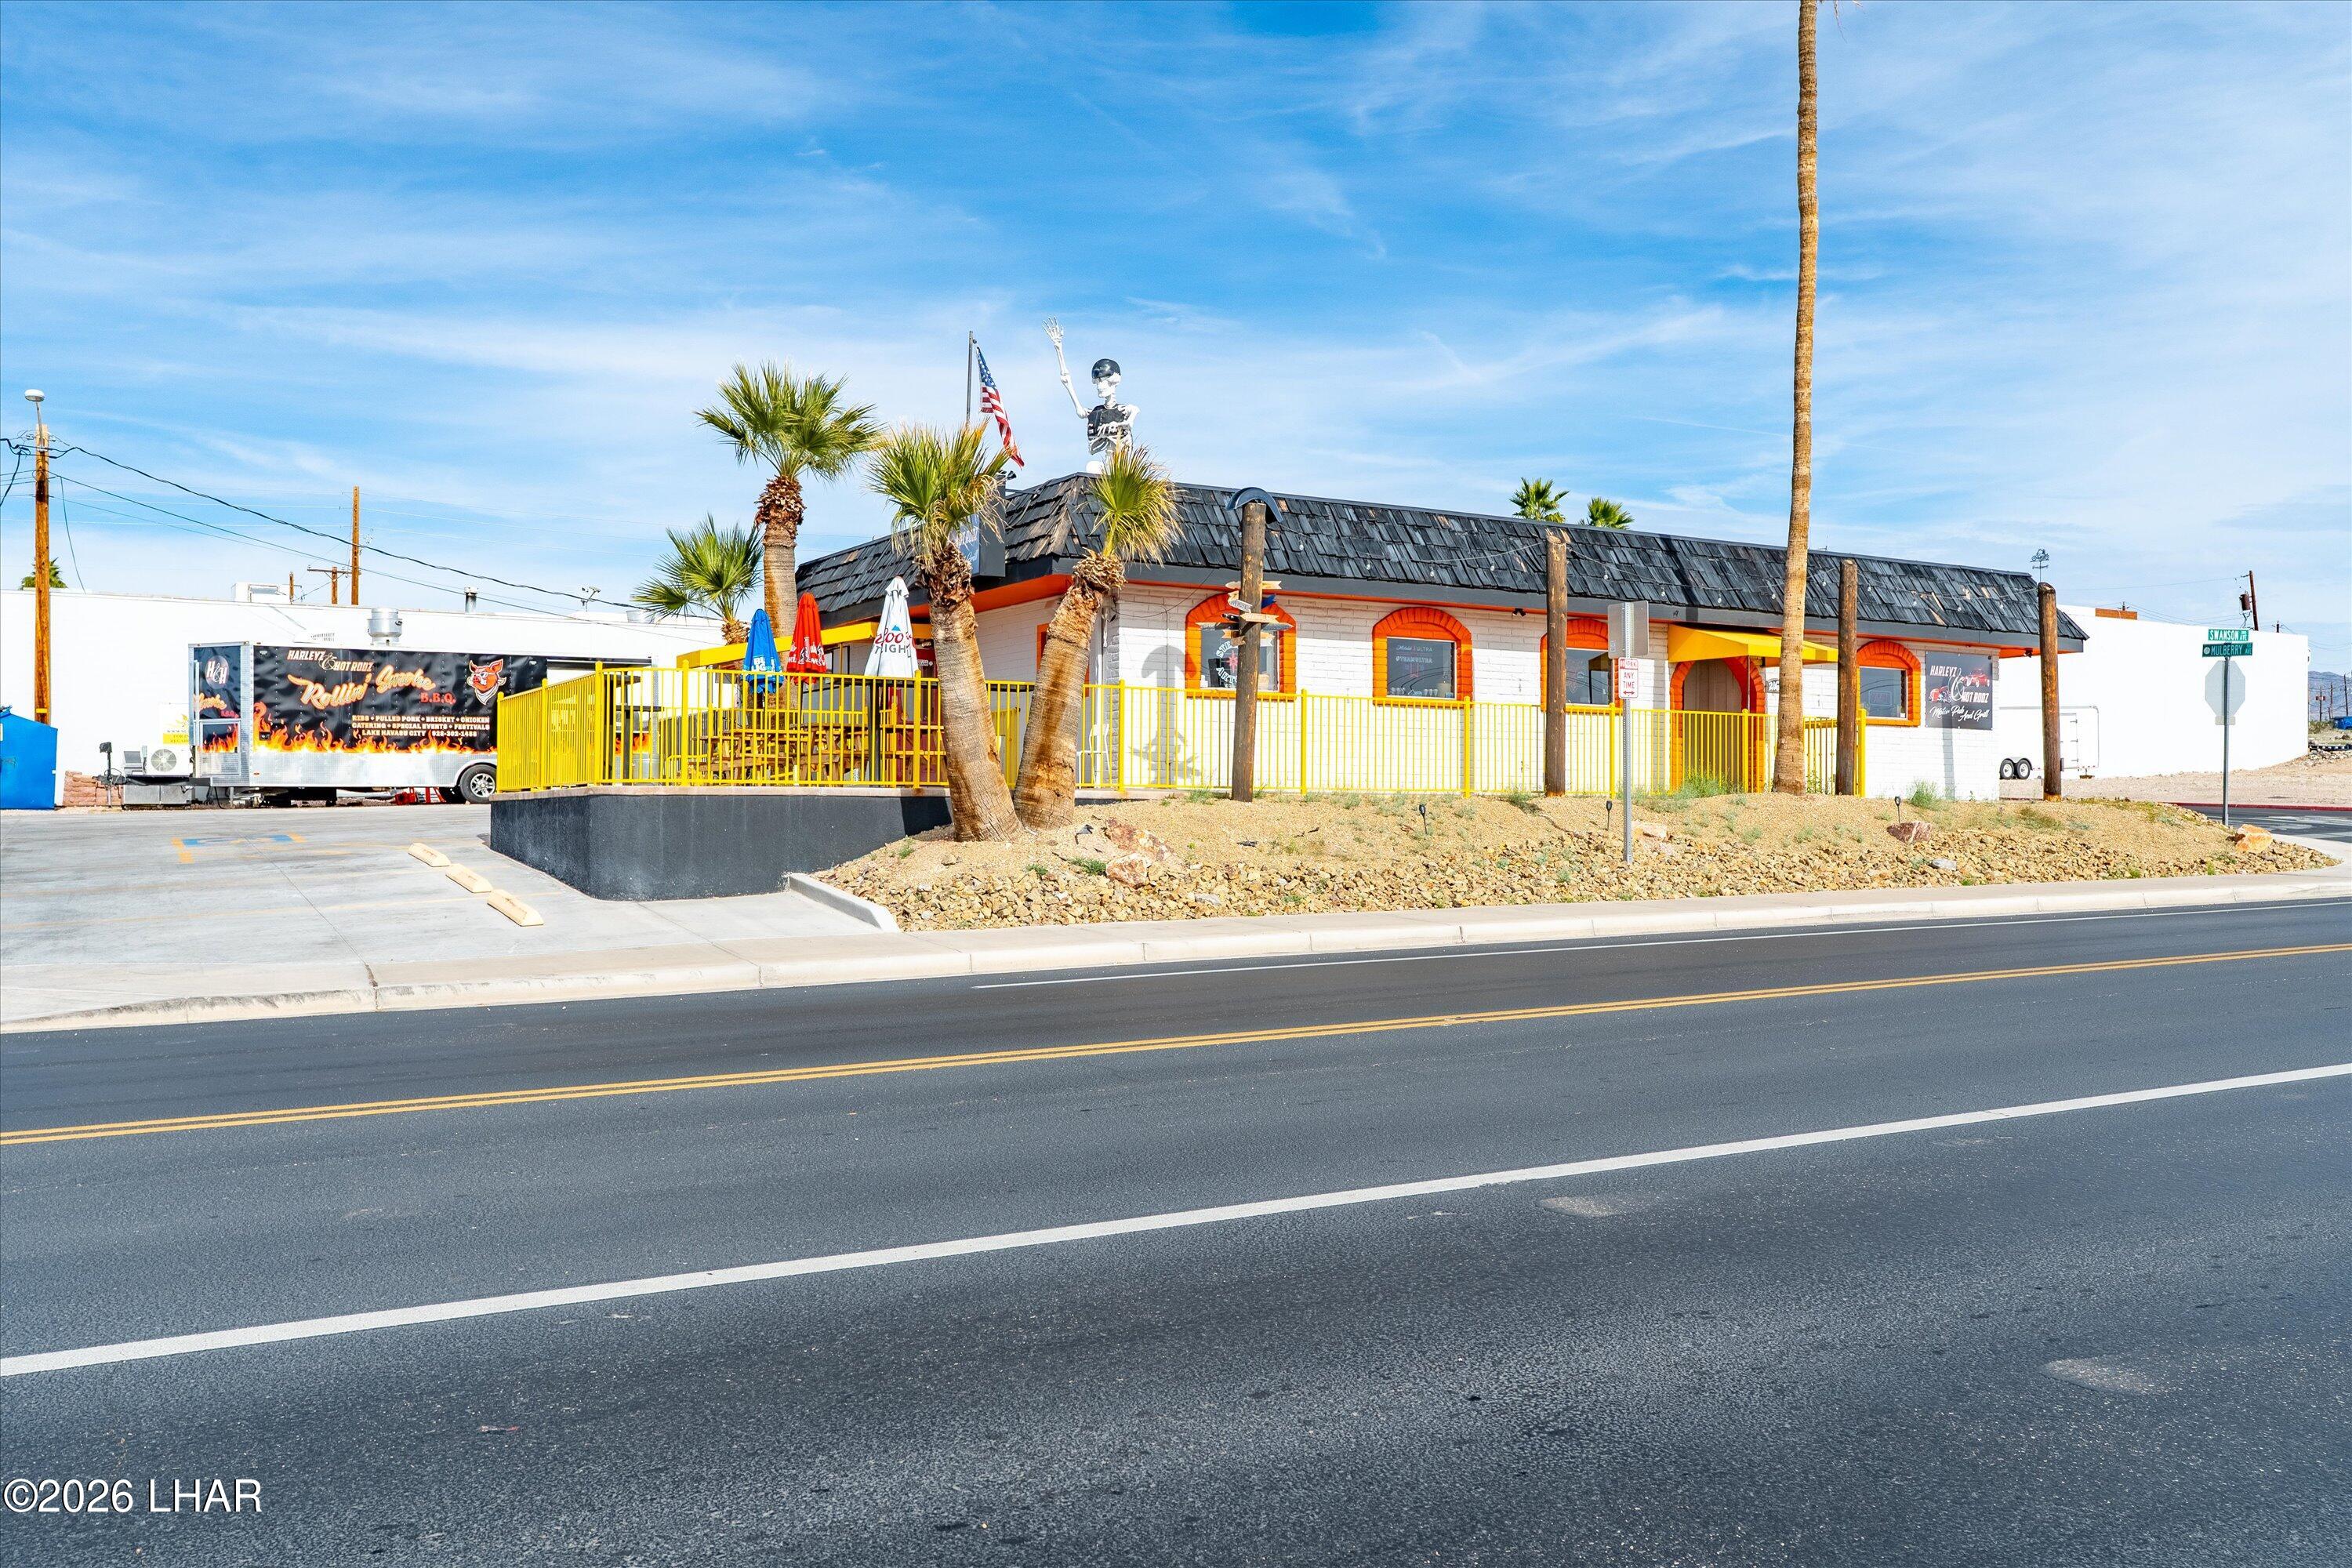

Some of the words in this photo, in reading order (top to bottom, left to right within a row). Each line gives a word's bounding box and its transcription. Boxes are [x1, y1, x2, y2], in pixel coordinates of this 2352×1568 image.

[2209, 630, 2239, 640] SWANSON
[2211, 644, 2242, 655] MULBERRY
[287, 650, 325, 661] HARLEYZ
[333, 661, 350, 671] HOT
[352, 662, 373, 672] RODZ
[1930, 665, 1958, 677] HARLEYZ
[375, 664, 436, 694] Smoke
[1623, 681, 1635, 689] TIME
[420, 692, 456, 705] B.B.Q.
[1961, 691, 1973, 702] HOT
[1973, 692, 1989, 703] RODZ
[1929, 706, 1950, 719] Motor
[1973, 709, 1990, 722] Grill
